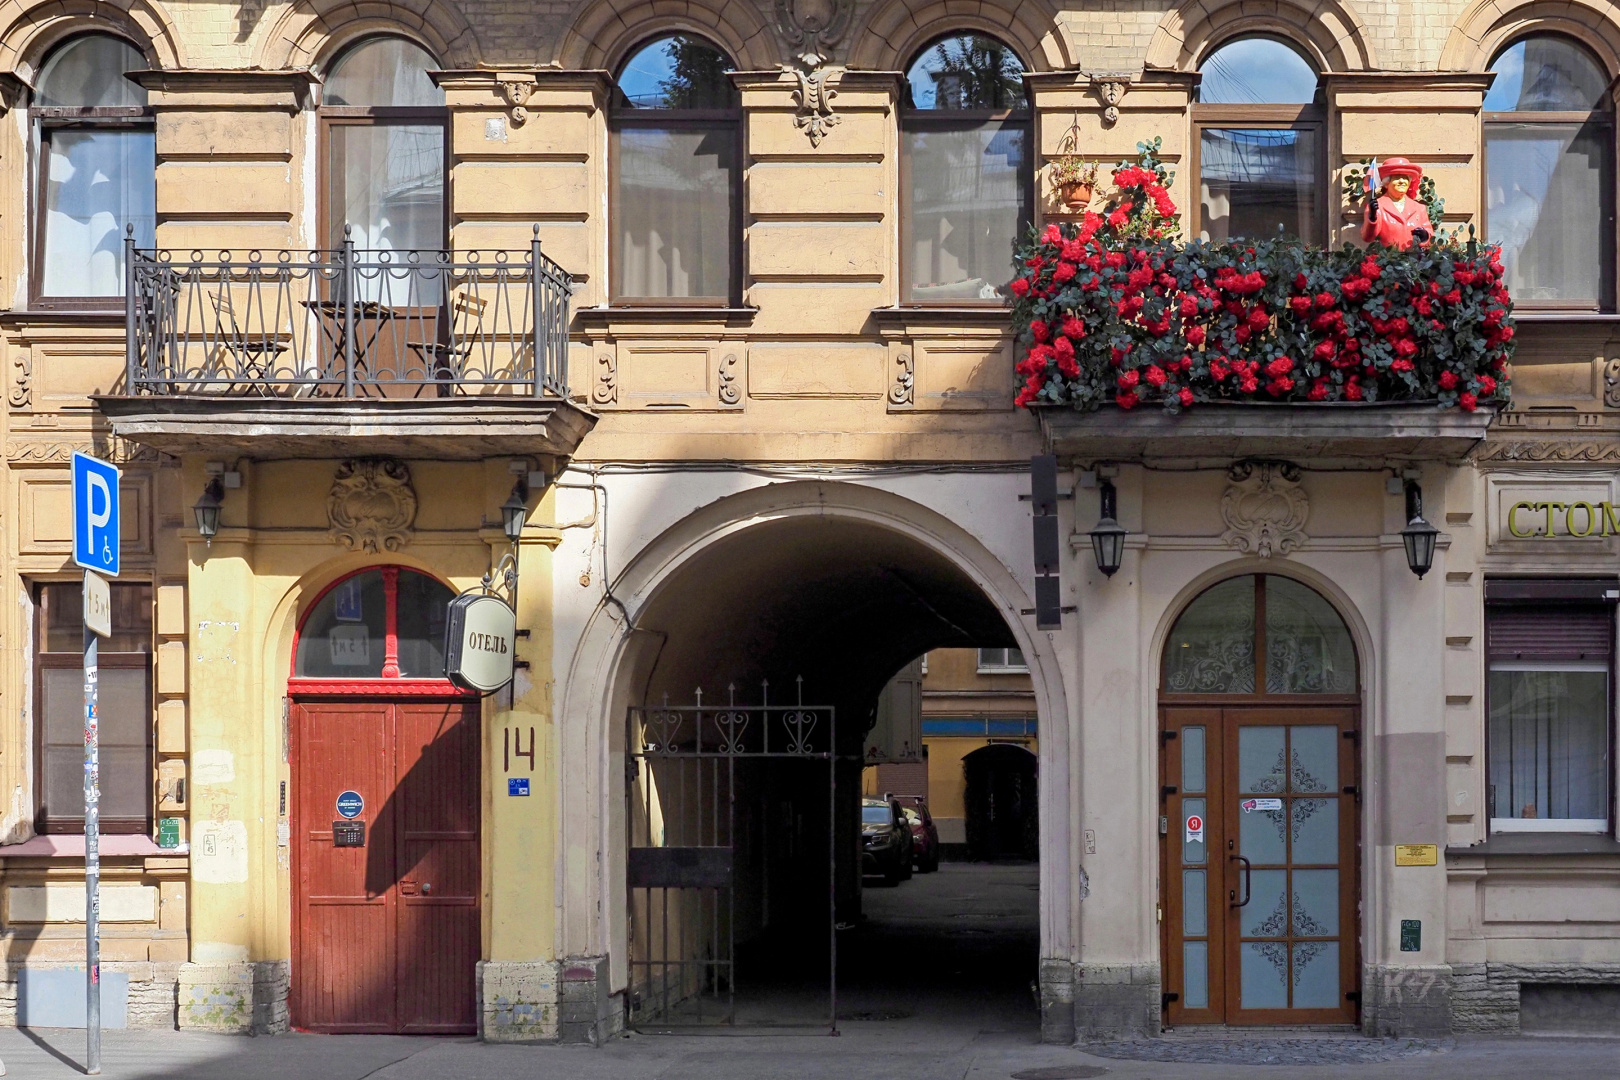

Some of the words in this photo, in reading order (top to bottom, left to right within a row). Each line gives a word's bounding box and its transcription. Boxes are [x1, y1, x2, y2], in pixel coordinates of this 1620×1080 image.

[87, 470, 111, 555] P
[95, 593, 99, 614] 5
[469, 631, 507, 655] ОТЕЛЬ
[504, 726, 535, 773] 14
[1191, 819, 1198, 828] Я
